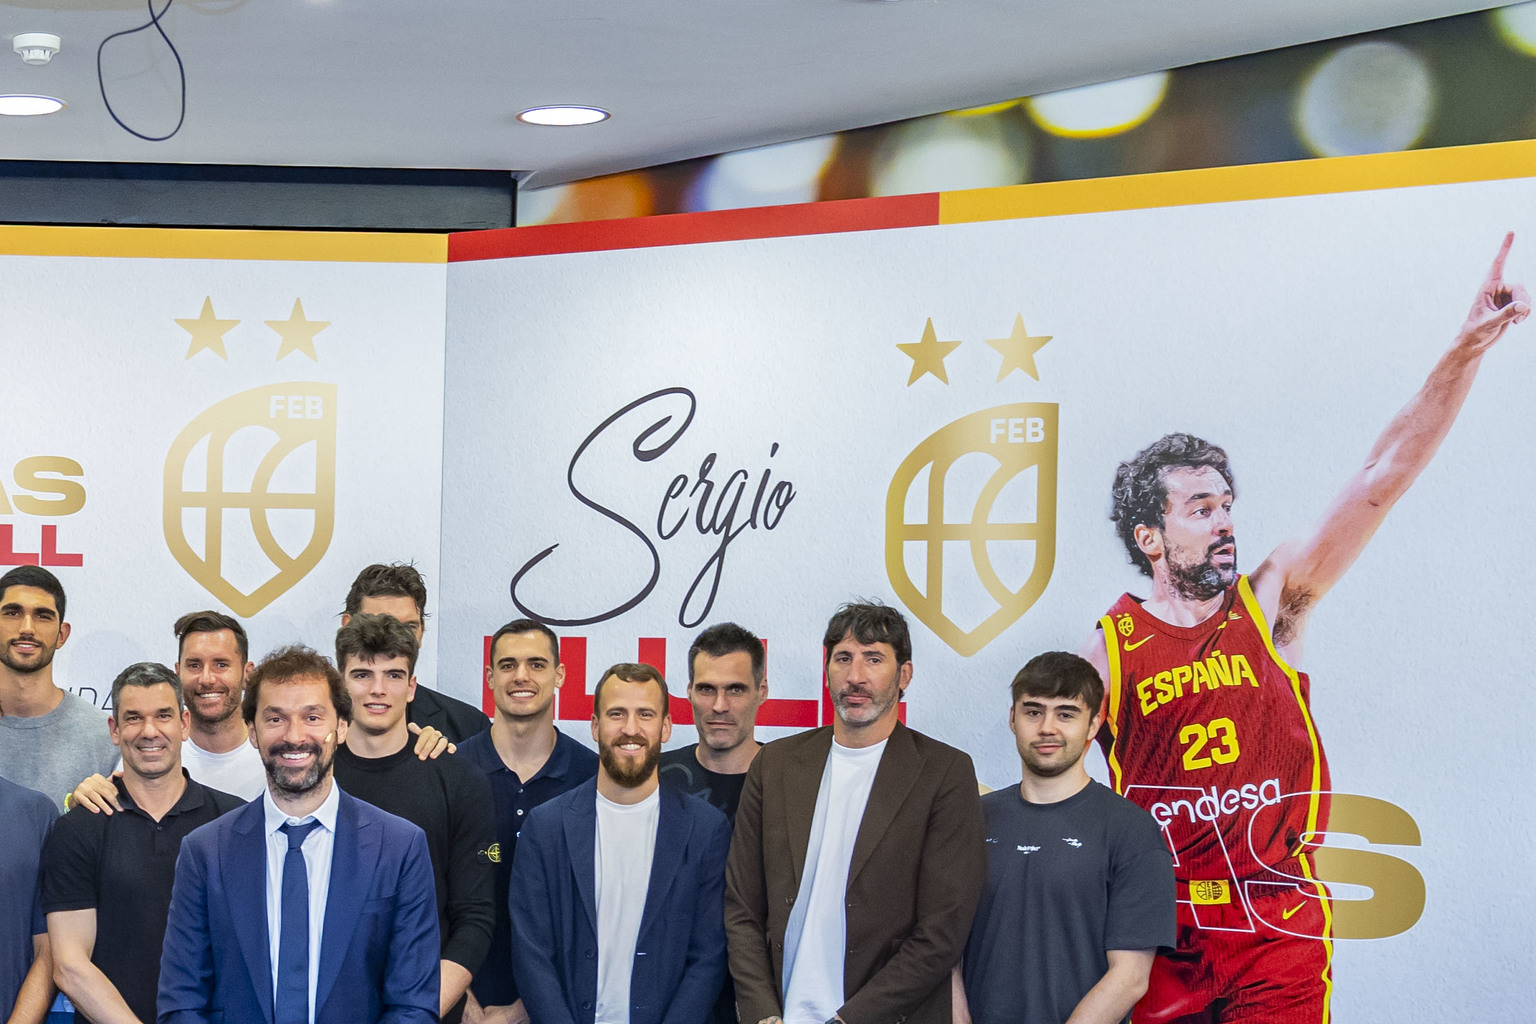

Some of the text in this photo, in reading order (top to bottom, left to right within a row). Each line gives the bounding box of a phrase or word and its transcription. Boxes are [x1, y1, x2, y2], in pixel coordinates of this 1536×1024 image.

[269, 394, 324, 420] FEB
[990, 417, 1045, 444] FEB
[510, 387, 796, 628] Sergio
[1136, 650, 1260, 716] ESPAÑA
[1178, 717, 1241, 771] 23
[1150, 778, 1282, 827] endesa
